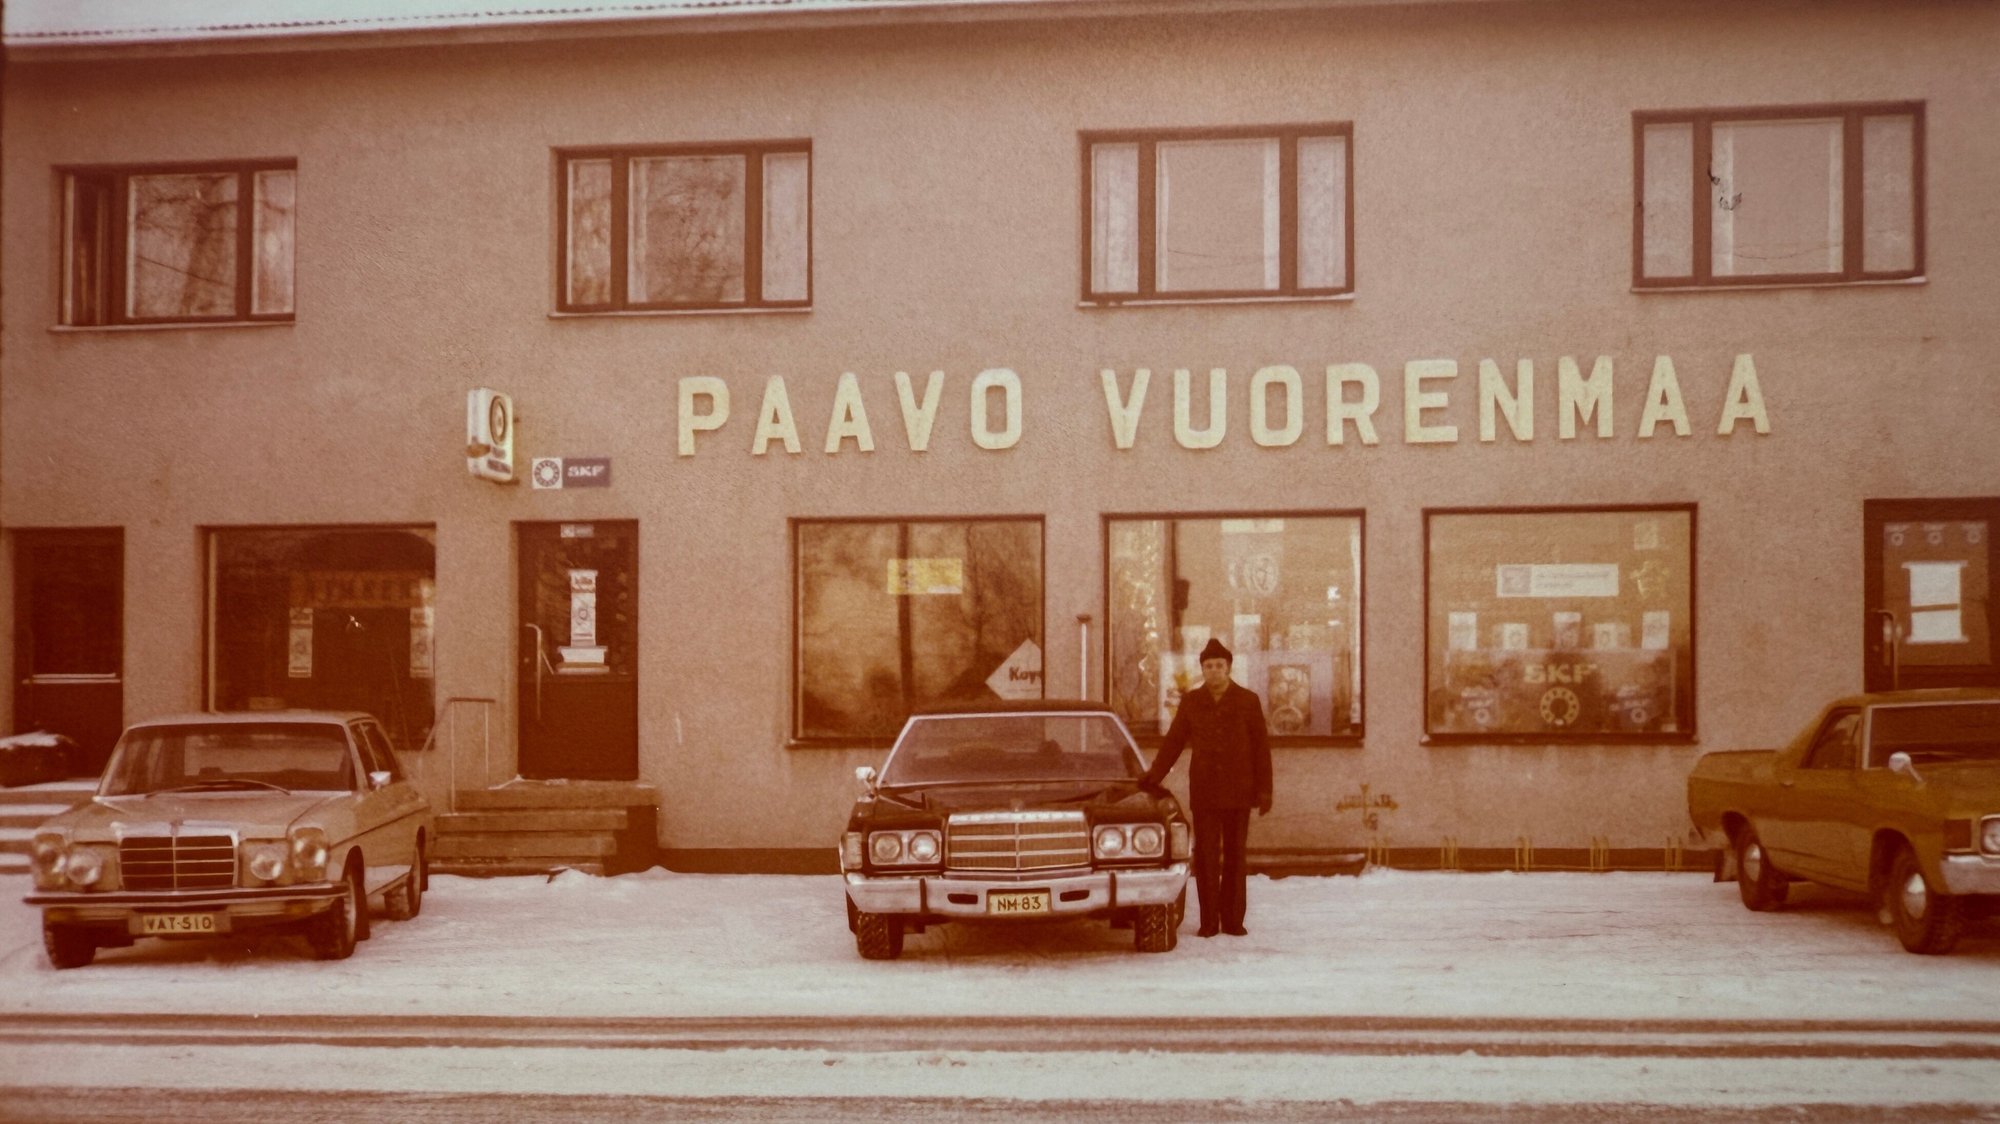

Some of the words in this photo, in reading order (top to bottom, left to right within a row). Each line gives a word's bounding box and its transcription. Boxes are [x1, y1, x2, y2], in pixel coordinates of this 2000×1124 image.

[678, 368, 1022, 456] PAAVO
[1101, 353, 1772, 449] VUORENMAA
[567, 465, 604, 478] SKF
[1524, 663, 1597, 684] SKF
[997, 896, 1041, 911] NM-83
